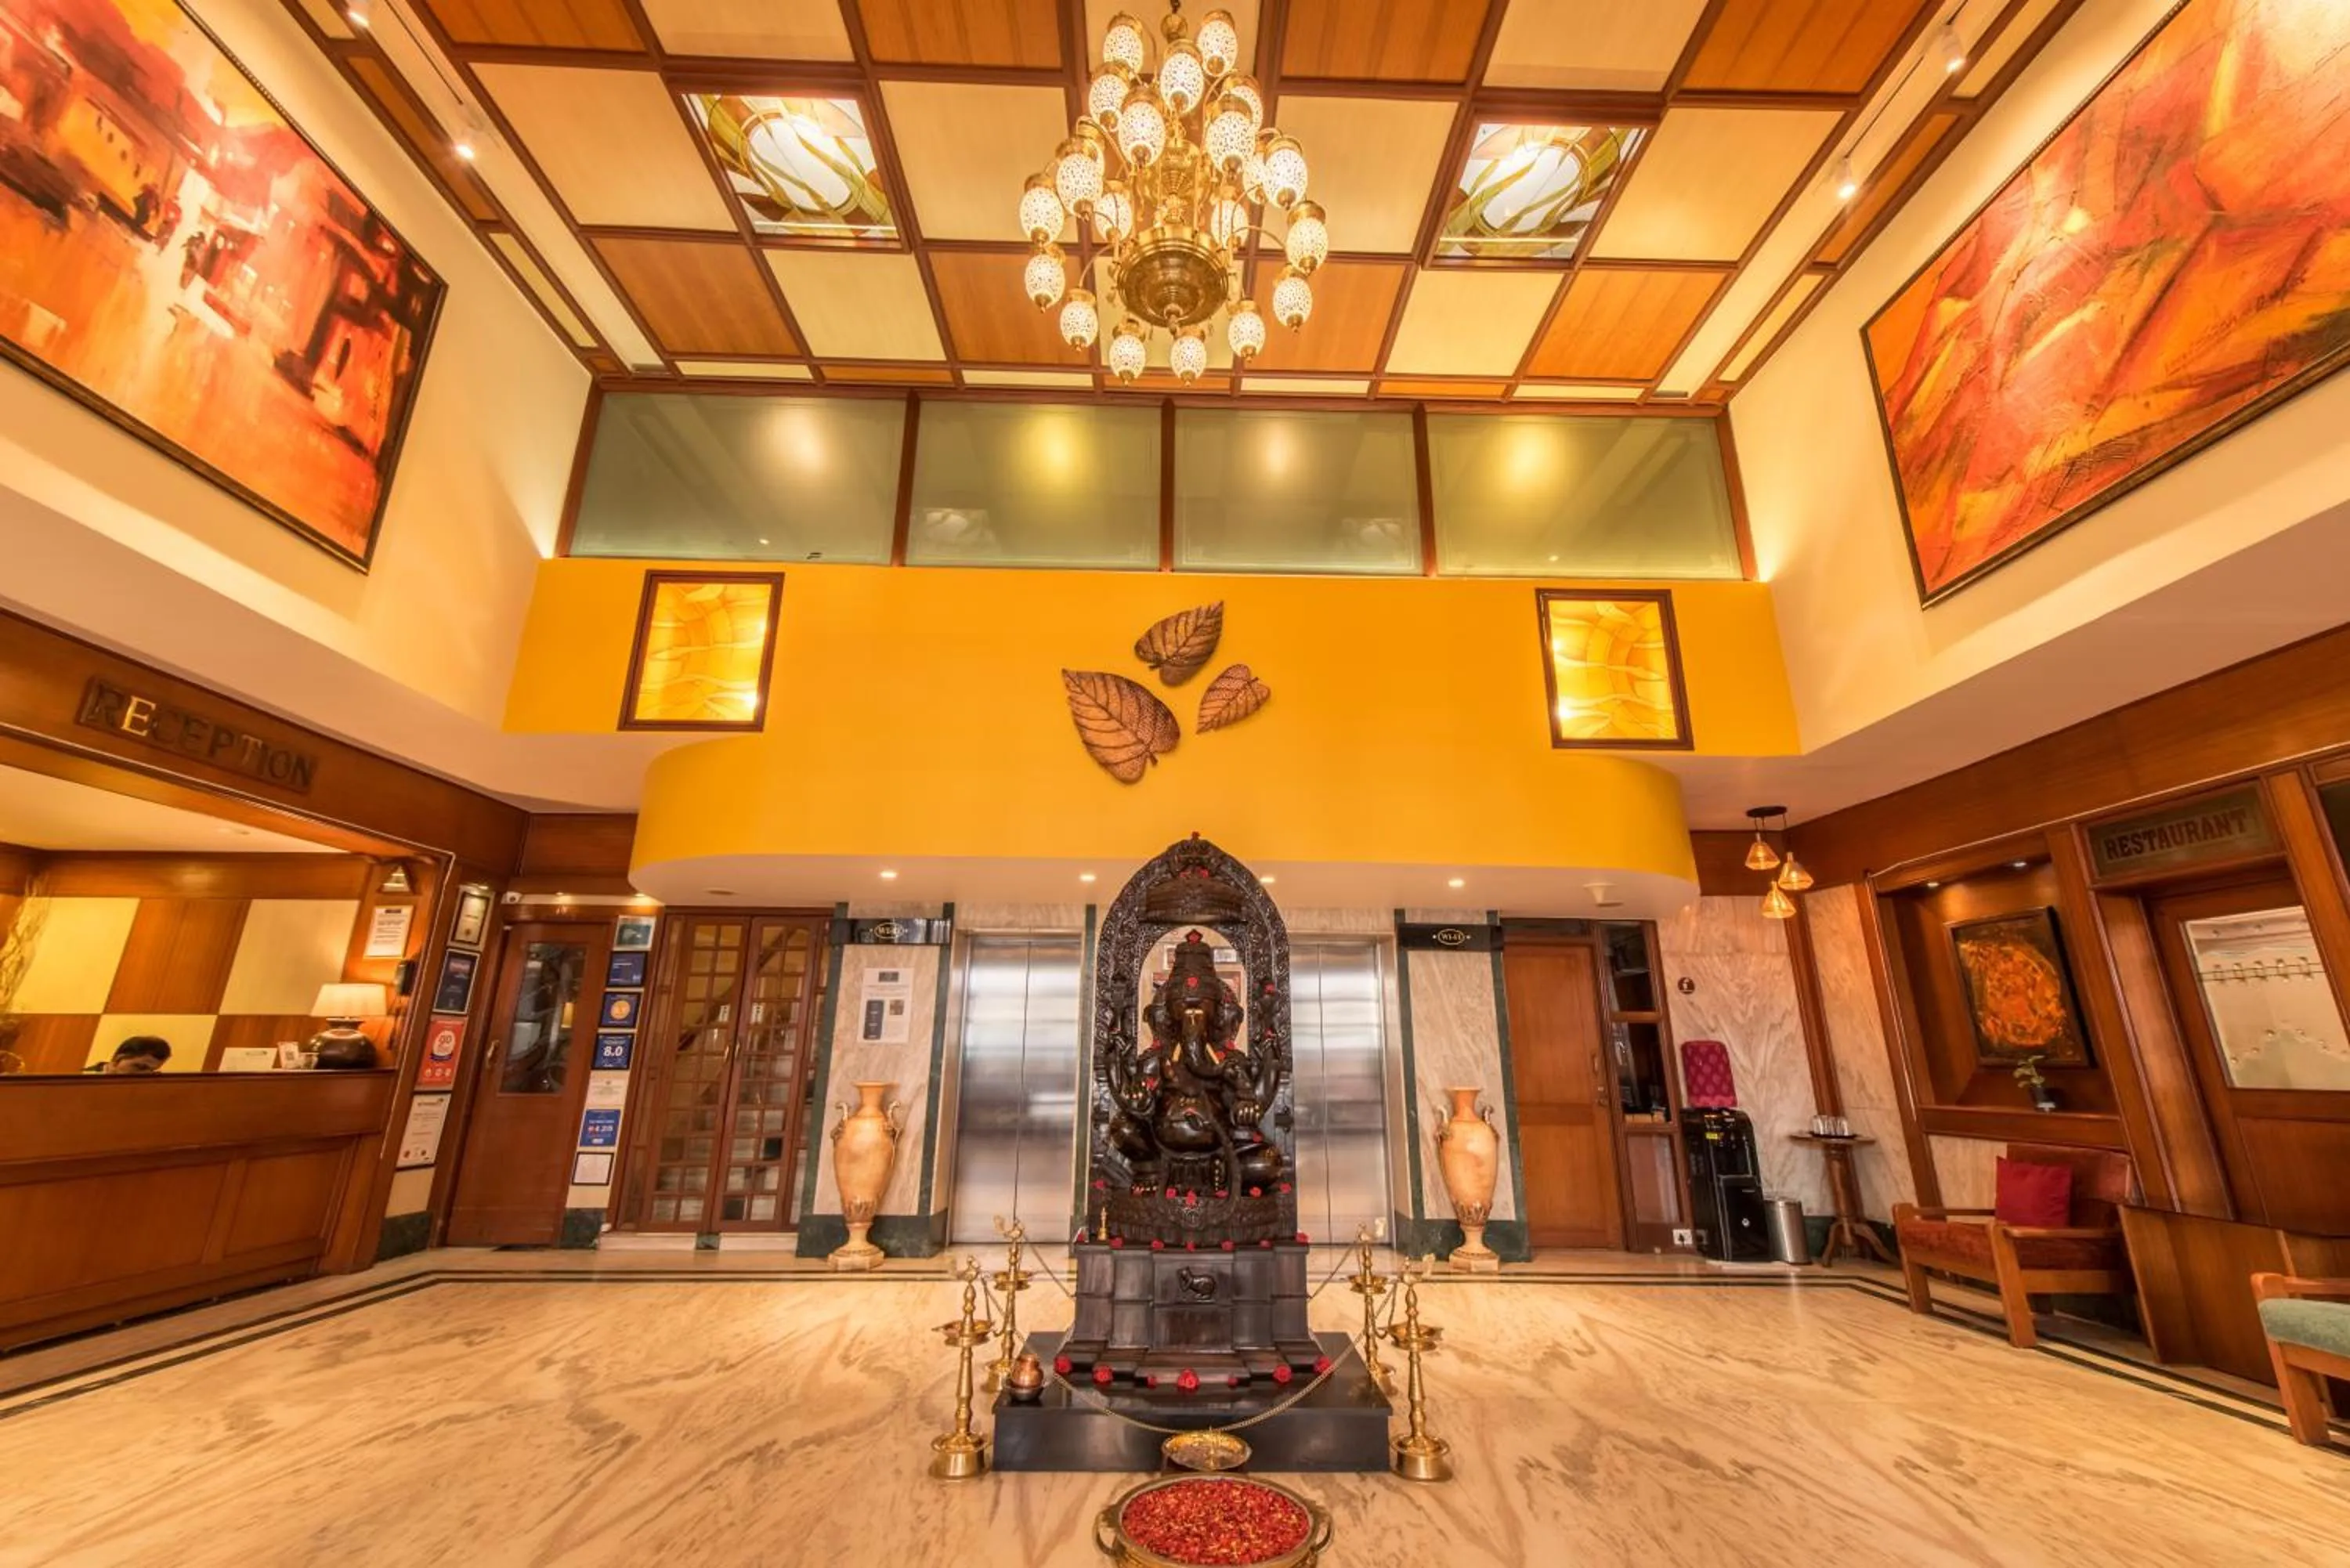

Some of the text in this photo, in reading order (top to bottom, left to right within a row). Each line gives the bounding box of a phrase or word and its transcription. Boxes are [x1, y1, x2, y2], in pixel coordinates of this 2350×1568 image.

[81, 682, 313, 786] RECEPTION
[2105, 807, 2247, 859] RESTAURANT
[603, 1046, 624, 1057] 8.0
